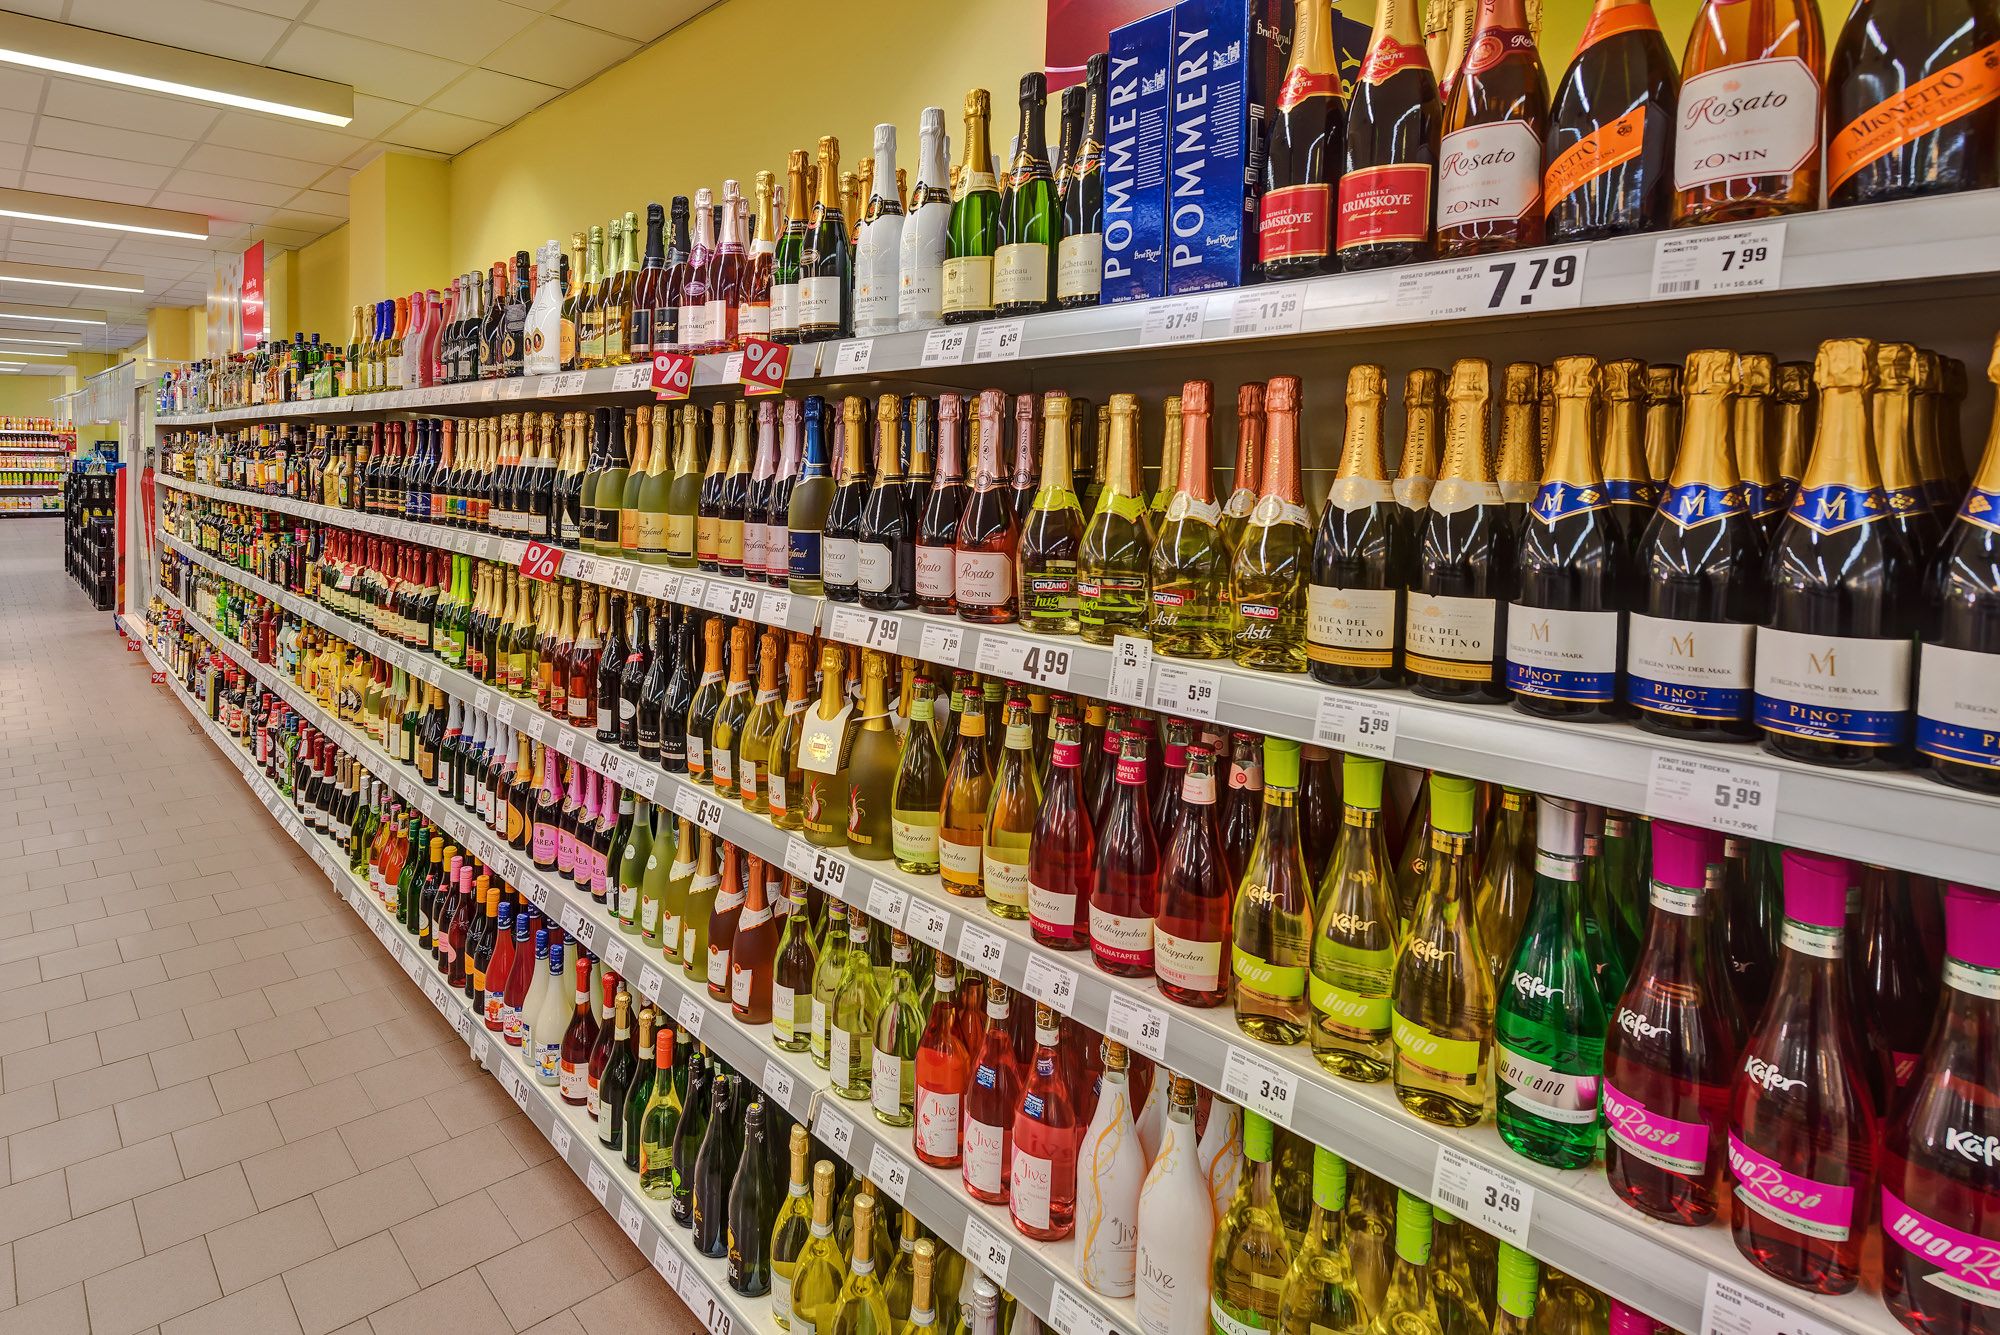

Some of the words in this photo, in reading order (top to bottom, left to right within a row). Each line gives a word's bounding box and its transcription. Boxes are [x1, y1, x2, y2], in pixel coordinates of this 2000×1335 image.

[1684, 91, 1787, 129] Rosato
[1851, 72, 1964, 139] MIONETTO
[1172, 29, 1208, 268] POMMERY
[1104, 56, 1138, 280] POMMERY
[1441, 148, 1515, 180] Rosato
[1694, 149, 1767, 170] ZONIN
[1356, 188, 1389, 199] KRIMSEKT
[1342, 195, 1411, 214] KRIMSKOYE
[1446, 198, 1499, 215] ZONIN
[1722, 247, 1767, 272] 7.99
[1488, 255, 1577, 308] 7.79
[1260, 300, 1296, 319] 11.99
[1165, 312, 1198, 329] 37.49
[941, 338, 962, 351] 12.99
[999, 333, 1017, 347] 6.49
[1415, 418, 1426, 474] VALENTINO
[577, 559, 593, 578] 5.99
[610, 565, 629, 586] 5.99
[960, 565, 995, 580] Rosato
[962, 589, 992, 598] ZONIN
[1034, 580, 1068, 590] CINZANO
[729, 590, 756, 613] 5.99
[1079, 600, 1098, 616] ugo
[1154, 594, 1182, 605] CINZANO
[1151, 611, 1180, 626] Asti
[1242, 606, 1276, 617] CINZANO
[1318, 615, 1341, 625] DUCA
[1346, 618, 1367, 626] DEL
[866, 616, 899, 646] 7.99
[1236, 624, 1272, 641] Asti
[1412, 623, 1434, 634] DUCA
[1439, 626, 1462, 637] DEL
[943, 638, 958, 651] 7.99
[1023, 647, 1069, 681] 4.99
[1561, 652, 1584, 660] MARK
[1518, 666, 1562, 683] PINOT
[1687, 665, 1705, 673] DER
[1707, 667, 1731, 675] MARK
[1188, 684, 1212, 700] 5.99
[1654, 684, 1708, 700] PINOT
[1803, 682, 1824, 692] VON
[1828, 685, 1849, 694] DER
[1851, 688, 1879, 696] MARK
[1789, 705, 1852, 724] PINOT
[1358, 716, 1389, 736] 5.99
[600, 752, 618, 774] 4.49
[1659, 756, 1680, 765] PINOT
[1700, 763, 1730, 774] TROCKEN
[1714, 784, 1761, 809] 5.99
[697, 800, 721, 826] 6.49
[813, 854, 846, 886] 5.99
[1246, 883, 1284, 904] Käfer
[576, 918, 594, 940] 2.99
[1332, 912, 1378, 935] Käfer
[1095, 943, 1141, 961] GRANATAPFEL
[1409, 937, 1456, 962] Käfer
[1237, 957, 1273, 983] Hugo
[1512, 969, 1565, 1000] Käfer
[1323, 992, 1369, 1018] Hugo
[1617, 1007, 1672, 1041] Käfer
[1396, 1024, 1439, 1056] Hugo
[1500, 1059, 1565, 1097] waldano
[1744, 1055, 1808, 1092] Käfer
[1260, 1080, 1287, 1101] 3.49
[931, 1101, 957, 1117] Jive
[973, 1128, 1000, 1150] Jive
[1020, 1163, 1048, 1183] Jive
[1484, 1186, 1520, 1213] 3.49
[988, 1247, 1006, 1265] 2.99
[1141, 1252, 1176, 1289] Jive
[1716, 1290, 1742, 1306] KAEFER
[1717, 1282, 1742, 1298] KAEFER
[1744, 1294, 1765, 1309] HUGO
[1766, 1305, 1785, 1319] ROSE
[707, 1298, 731, 1335] 1.79
